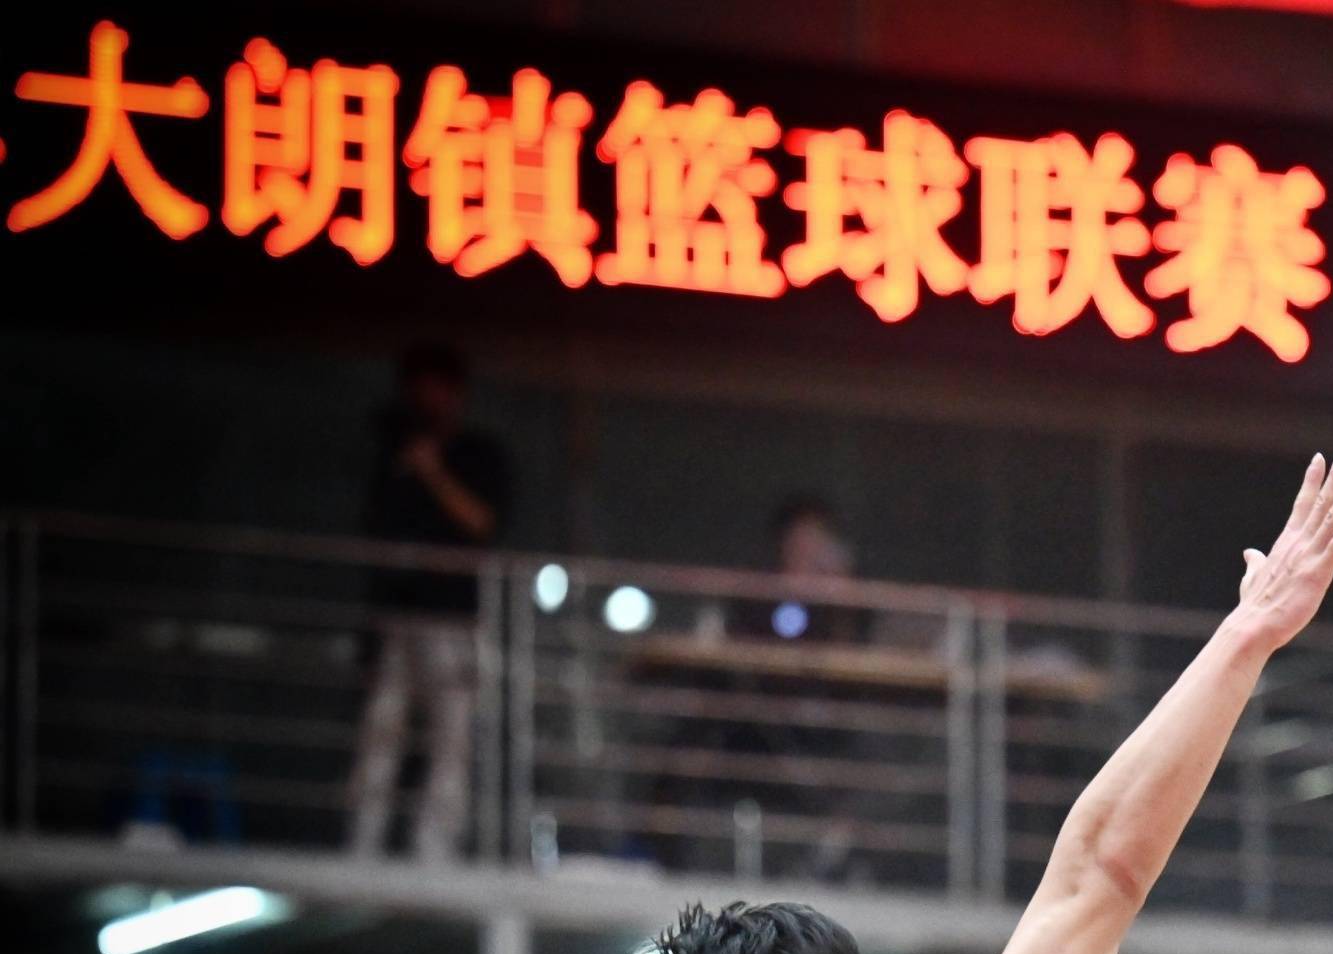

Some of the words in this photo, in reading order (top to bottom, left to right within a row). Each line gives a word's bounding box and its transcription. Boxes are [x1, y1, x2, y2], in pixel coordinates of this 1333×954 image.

[8, 20, 1331, 362] 大朗镇篮球联赛
